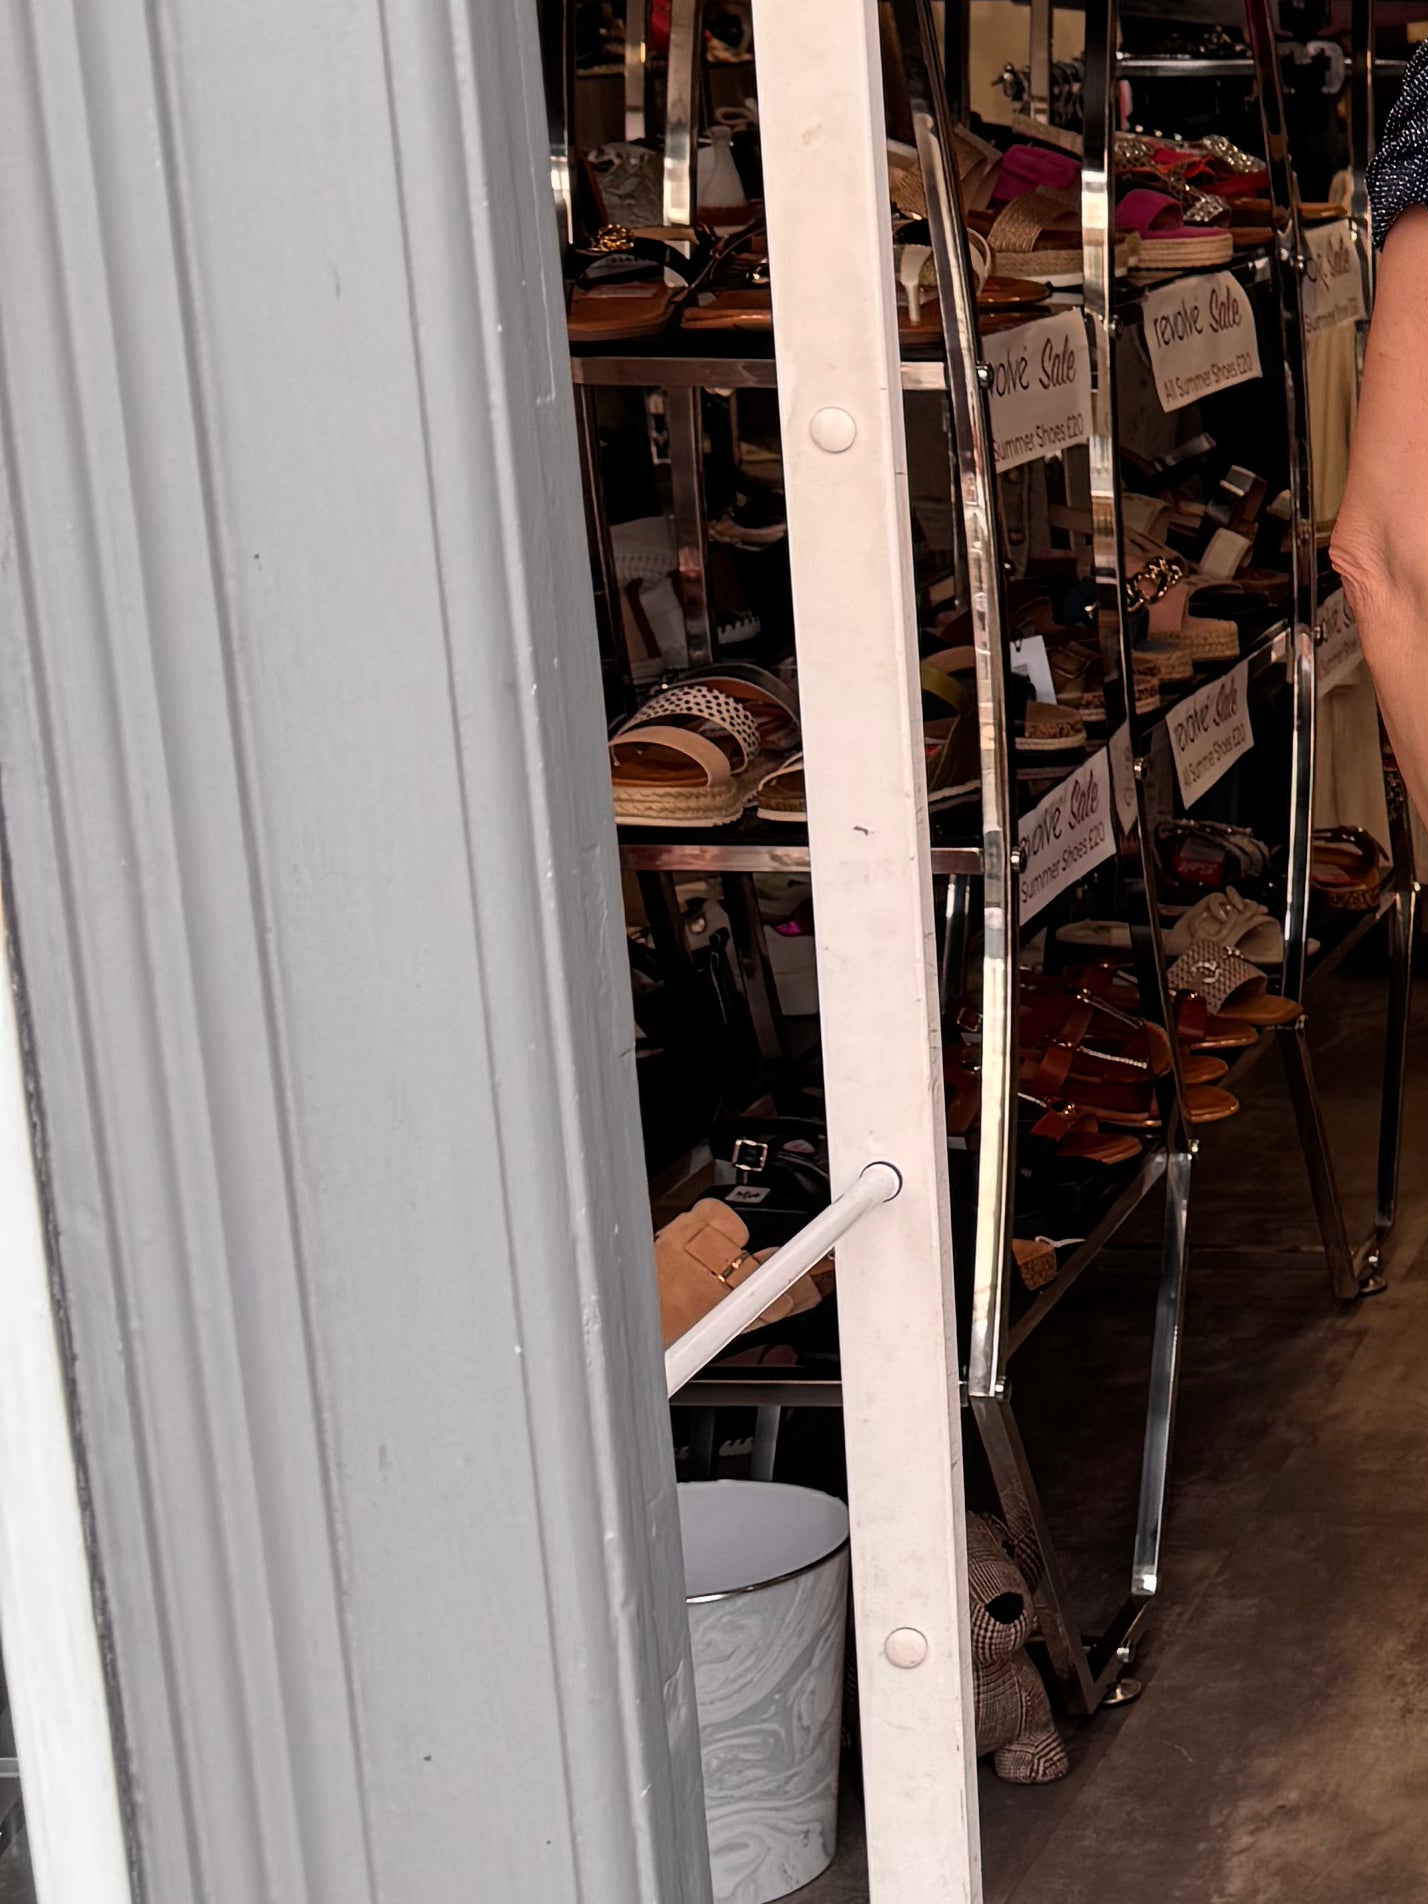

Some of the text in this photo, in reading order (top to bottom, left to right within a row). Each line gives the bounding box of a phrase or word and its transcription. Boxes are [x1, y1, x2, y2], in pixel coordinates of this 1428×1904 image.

[1153, 284, 1242, 348] revolve Sale
[1039, 334, 1077, 391] Sale
[1164, 351, 1253, 403] All Summer Shoes £20
[1035, 423, 1065, 448] Shoes
[1067, 412, 1084, 439] £20
[1212, 674, 1238, 728] Sale
[1068, 768, 1100, 832] Sale
[1020, 821, 1106, 904] Summer Shoes £20
